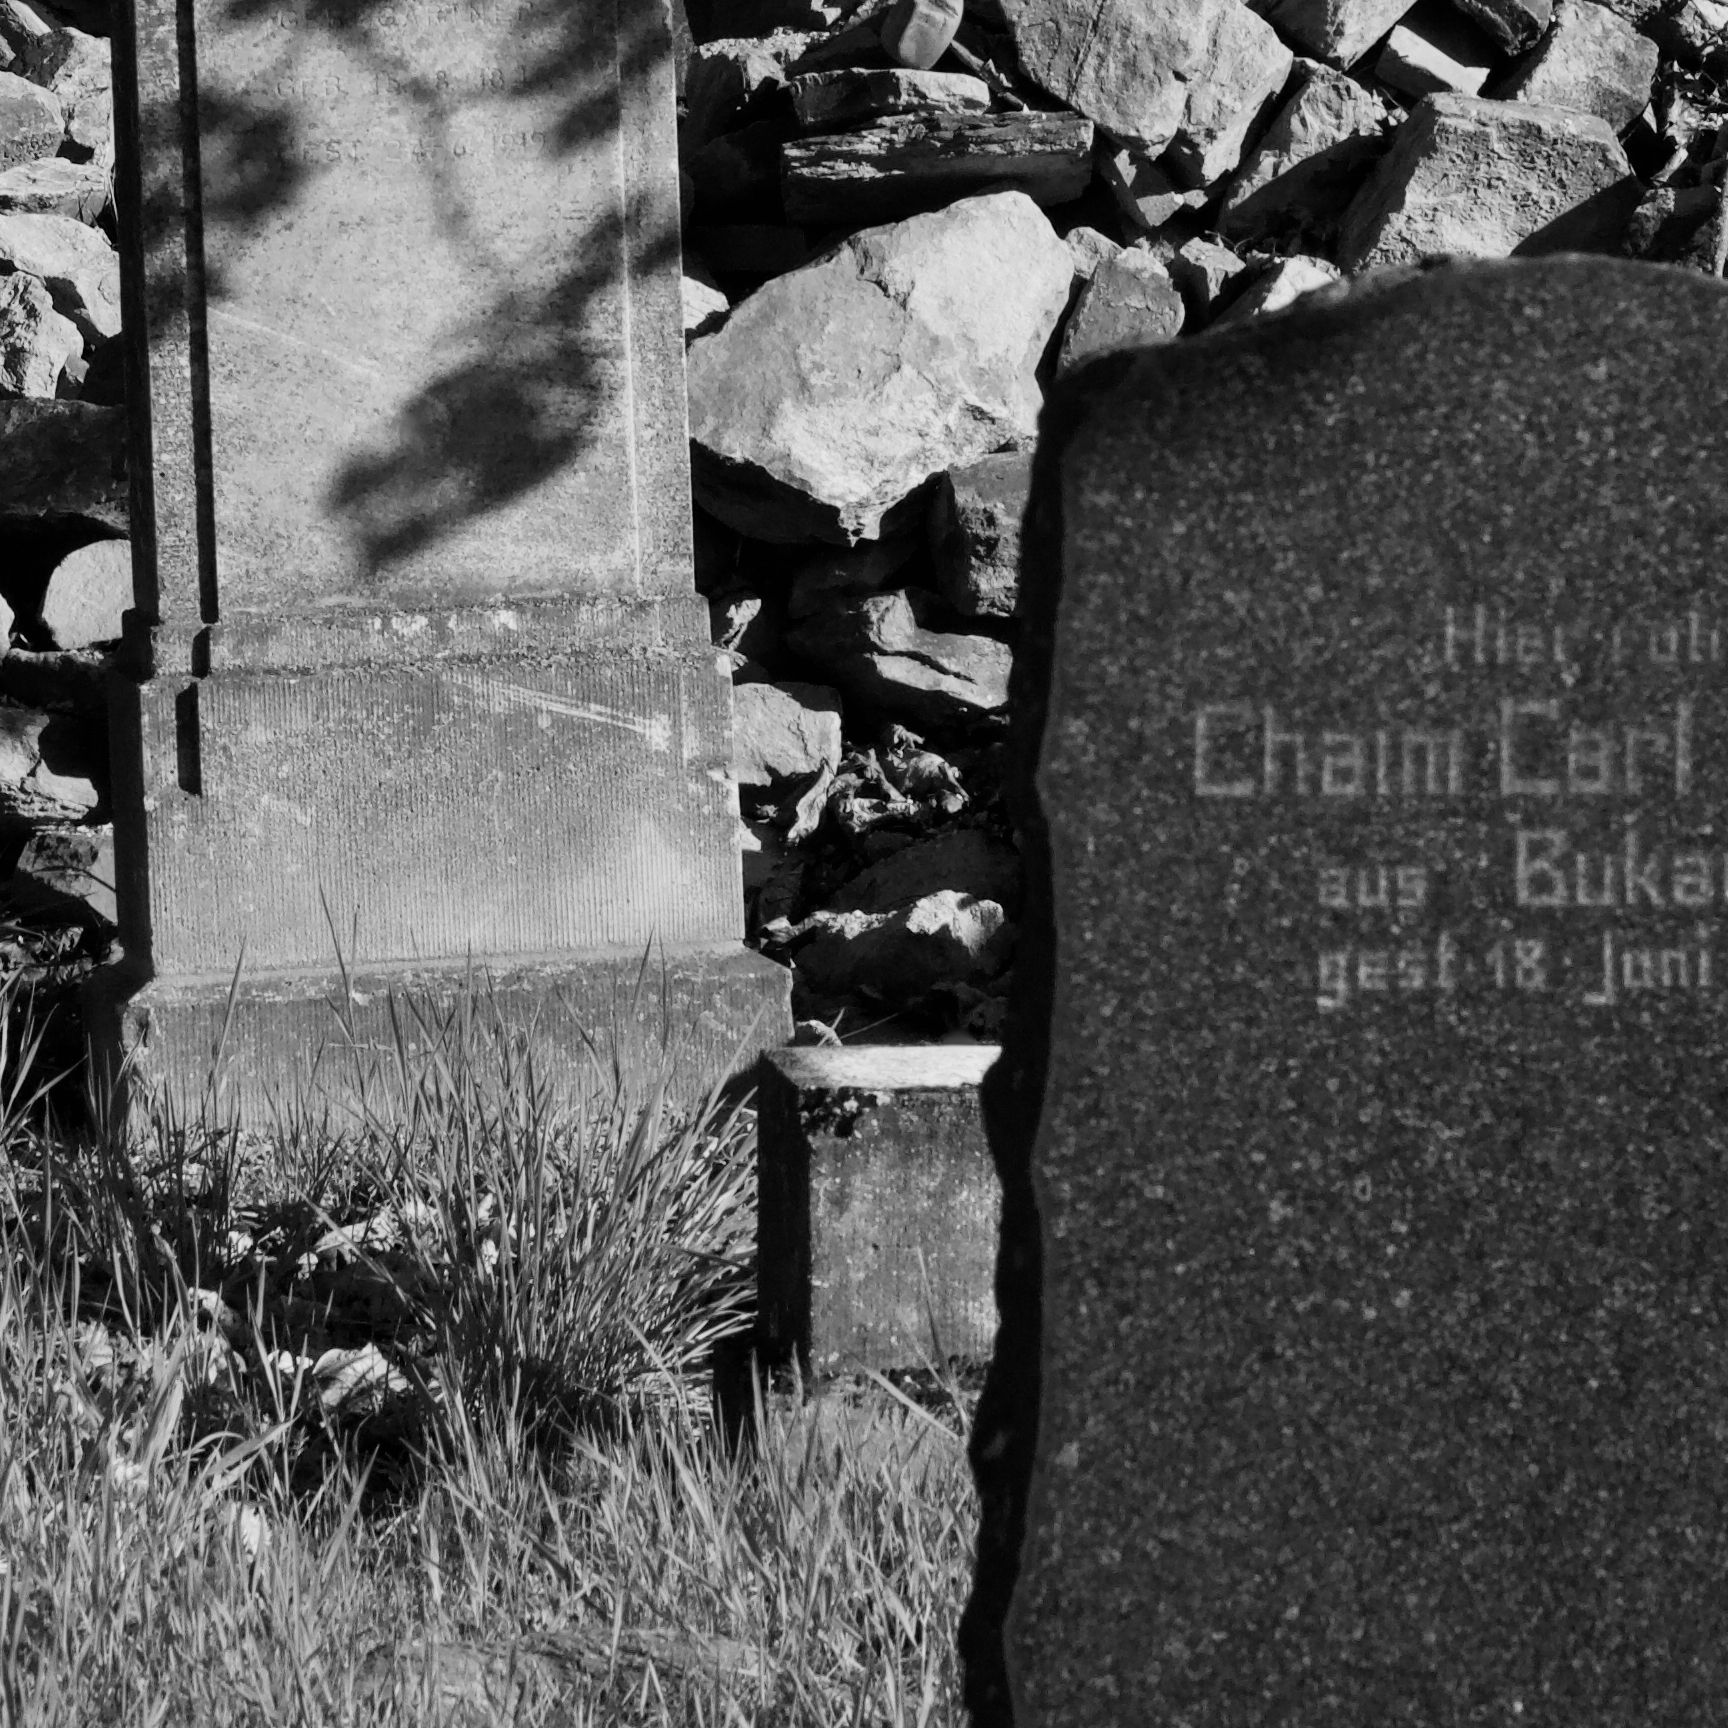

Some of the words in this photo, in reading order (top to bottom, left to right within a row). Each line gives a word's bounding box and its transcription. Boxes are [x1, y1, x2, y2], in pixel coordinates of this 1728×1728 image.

[1193, 699, 1463, 797] Chaim
[1498, 697, 1693, 797] Carl
[1316, 867, 1430, 909] aus
[1582, 927, 1711, 1007] Juni
